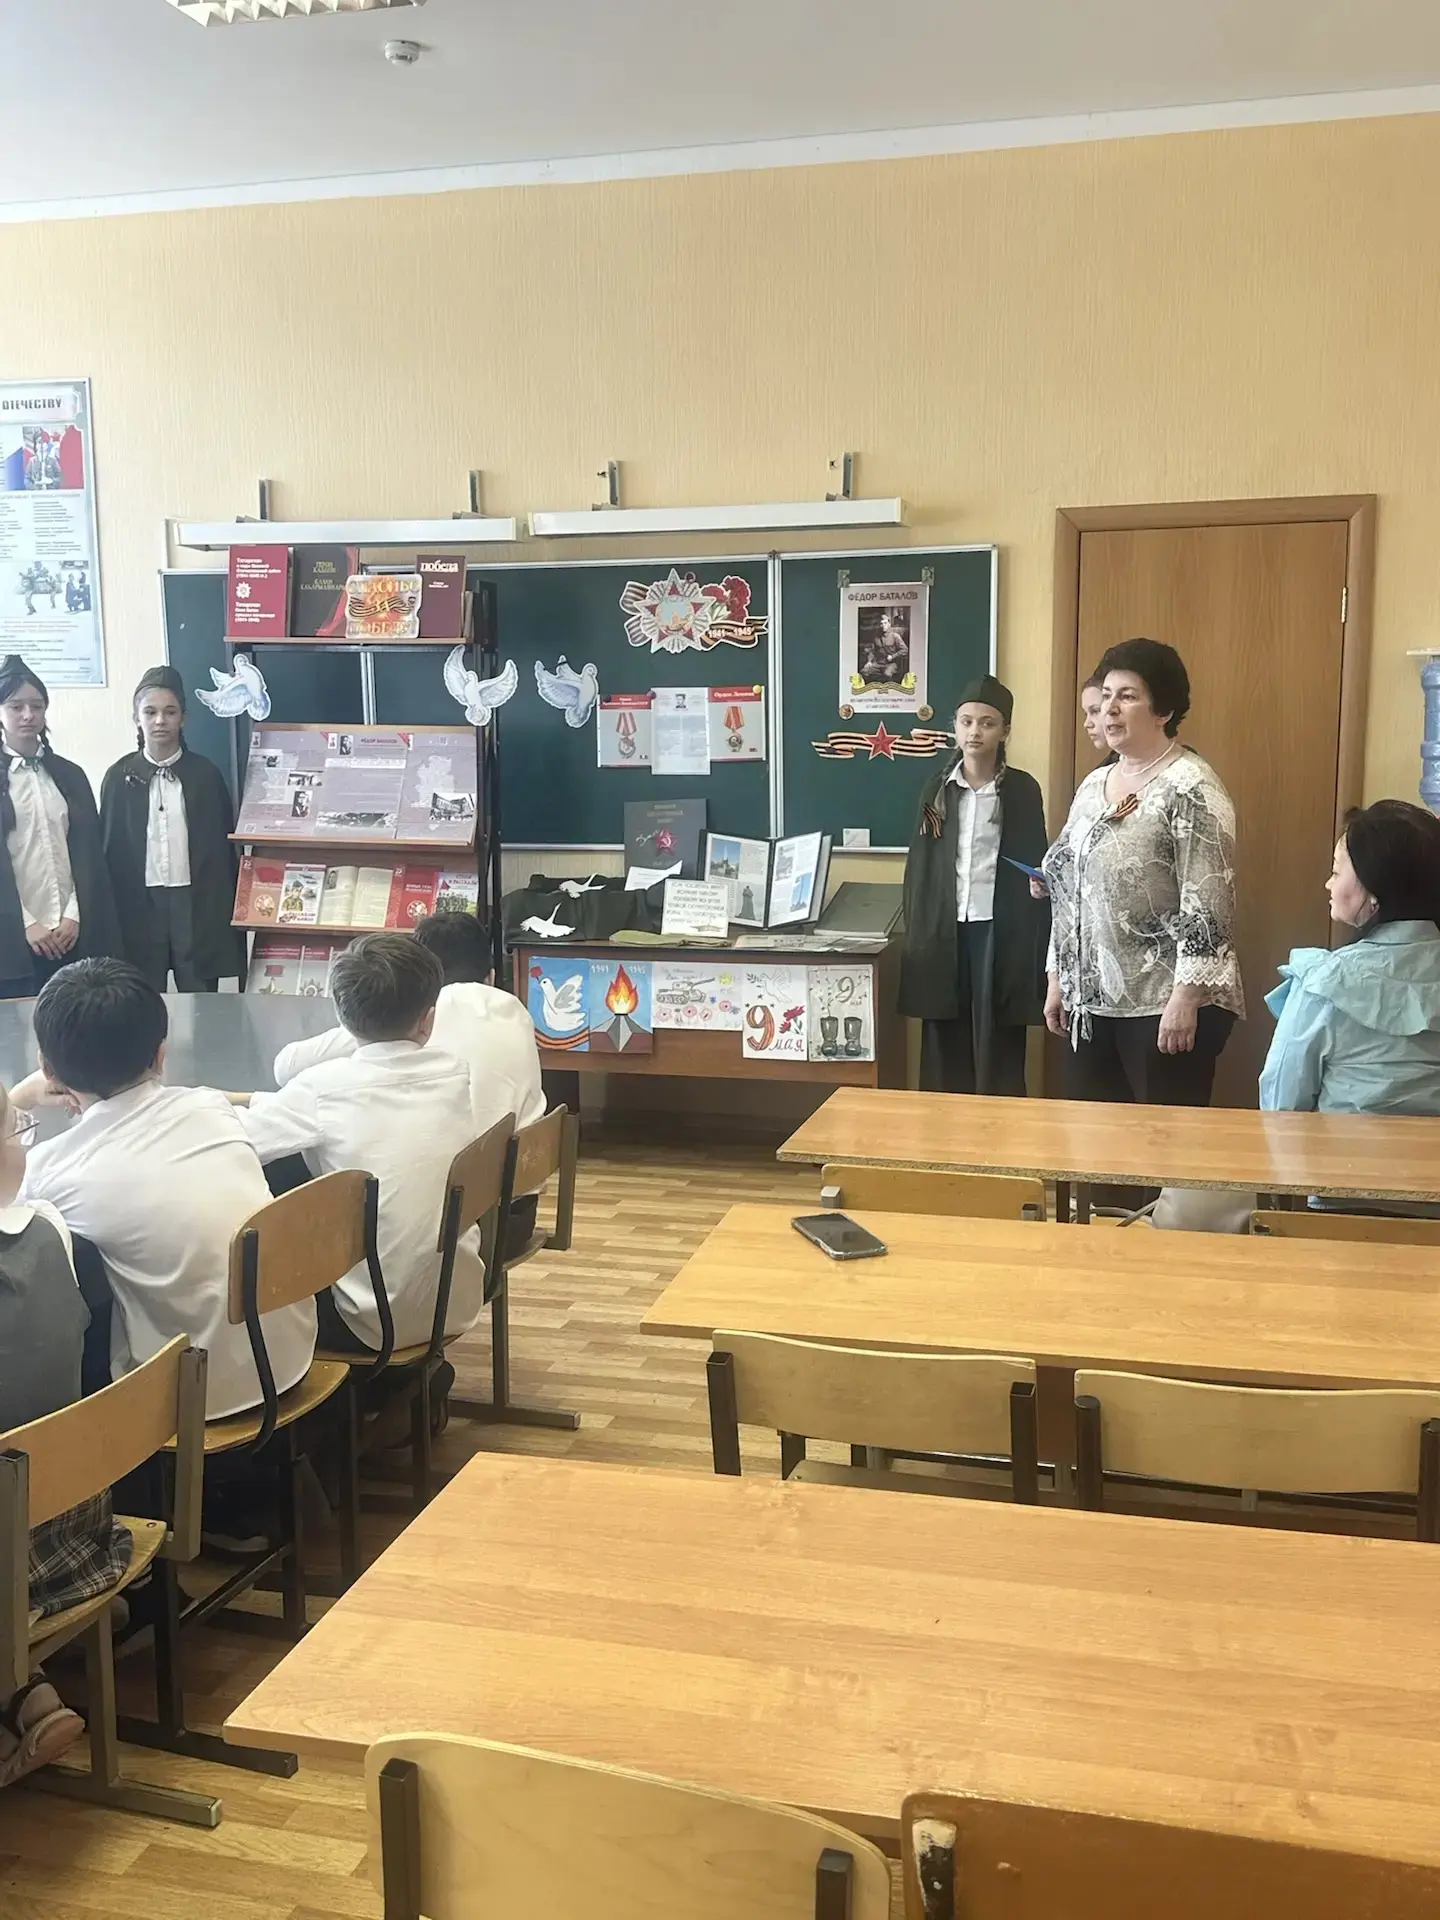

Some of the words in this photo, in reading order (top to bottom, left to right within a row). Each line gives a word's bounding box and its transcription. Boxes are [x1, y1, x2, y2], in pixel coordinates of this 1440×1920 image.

[2, 398, 62, 410] ОТЕЧЕСТВУ
[836, 976, 855, 1003] 9
[746, 1005, 775, 1051] 9
